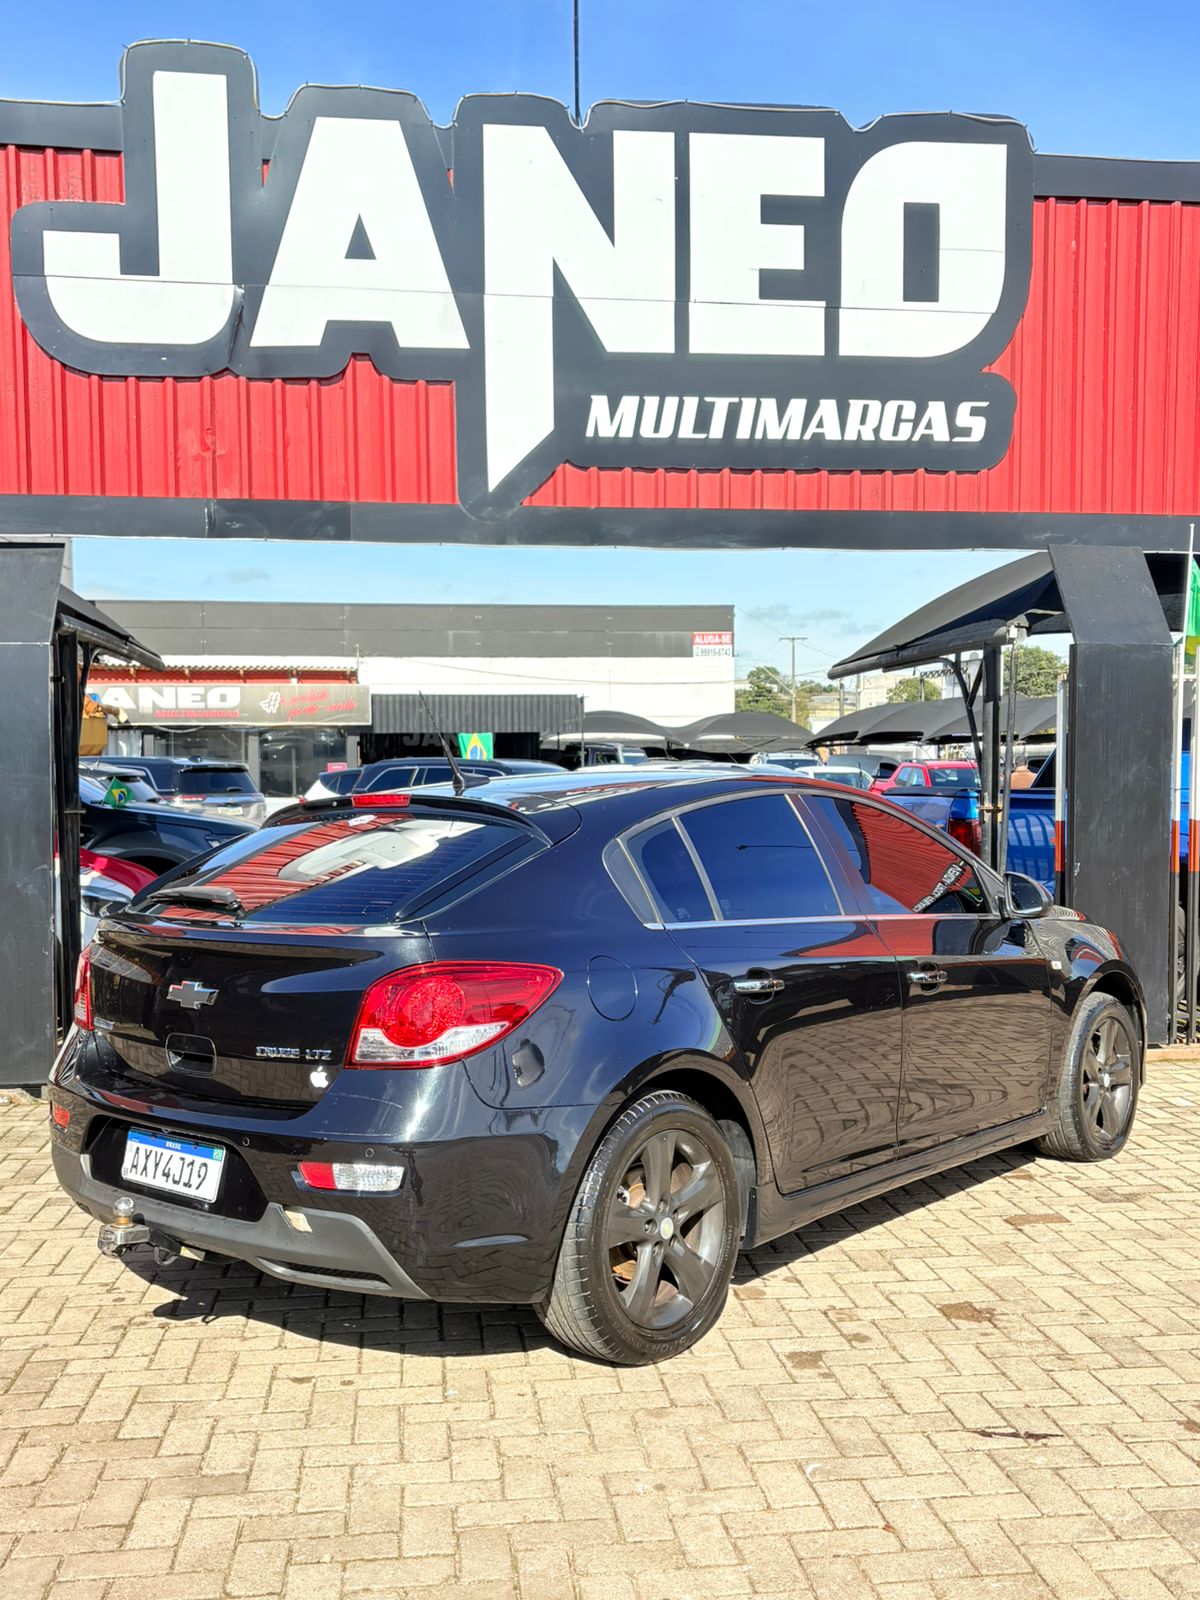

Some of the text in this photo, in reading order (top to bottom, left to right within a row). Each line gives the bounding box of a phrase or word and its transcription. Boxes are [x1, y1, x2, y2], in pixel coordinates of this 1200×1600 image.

[43, 71, 1008, 492] JANEO
[585, 395, 990, 442] MULTIMARCAS
[694, 633, 731, 645] ALUGA-SE
[305, 1048, 333, 1061] LTZ
[129, 1146, 209, 1191] AXY4J19
